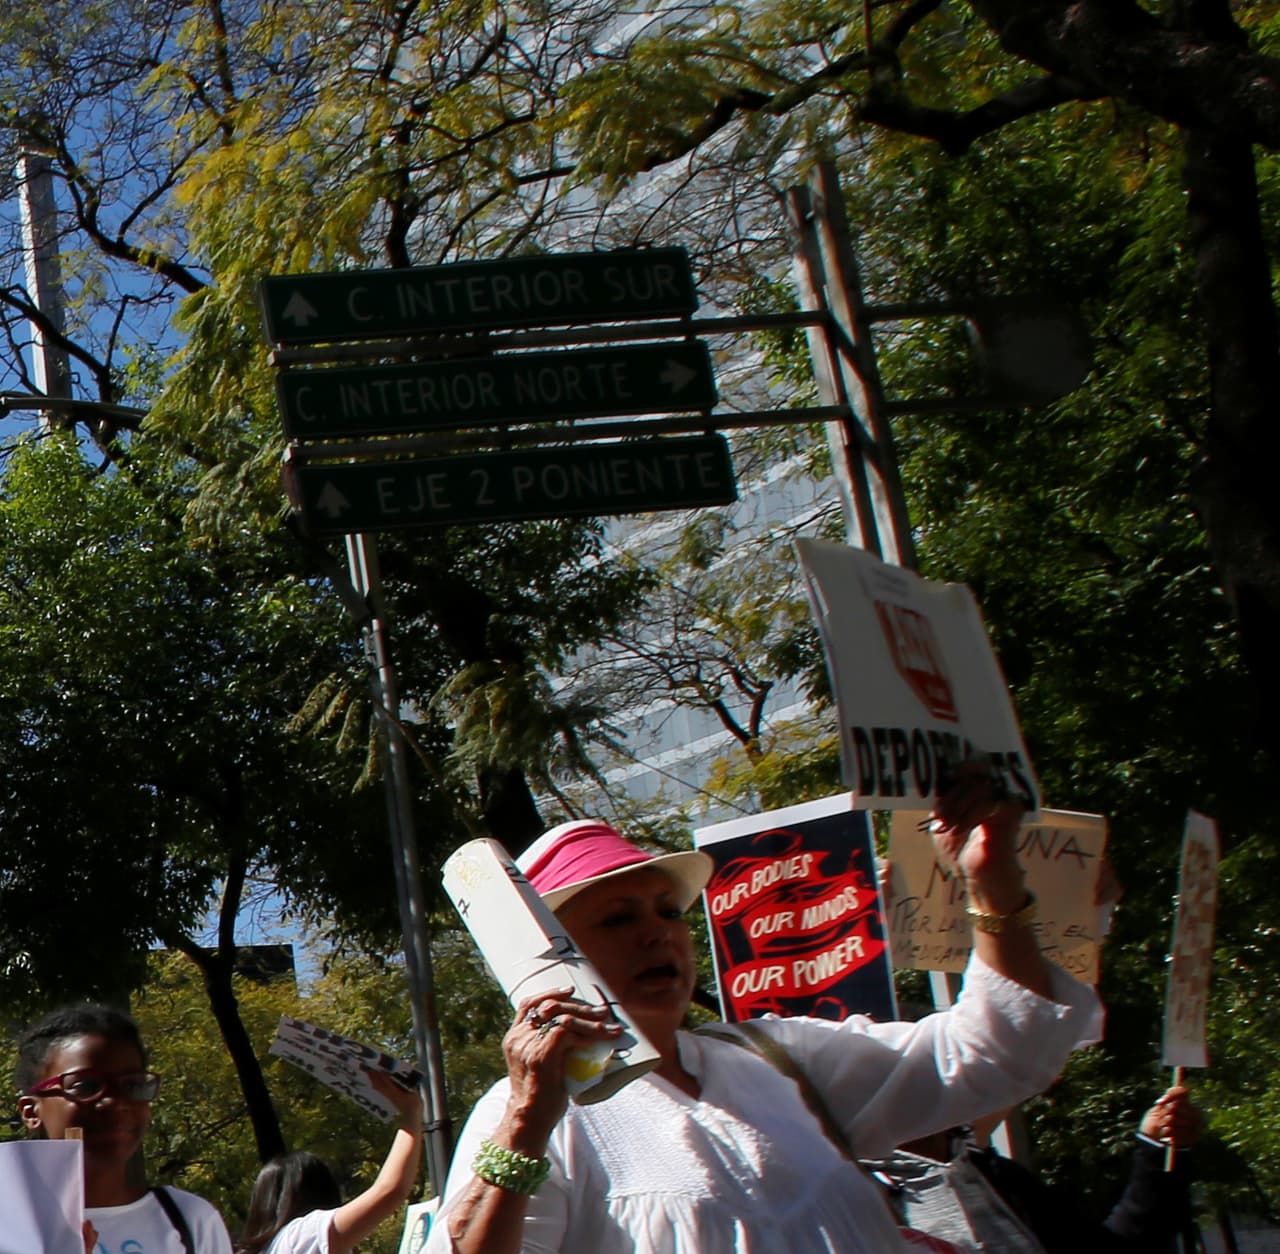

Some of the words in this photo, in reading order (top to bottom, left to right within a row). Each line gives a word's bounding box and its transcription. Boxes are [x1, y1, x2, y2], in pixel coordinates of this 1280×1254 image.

[396, 269, 593, 320] INTERIOR
[603, 263, 681, 303] SUR
[339, 370, 502, 419] INTERIOR
[513, 360, 633, 407] NORTE
[376, 472, 451, 514] EJE
[470, 469, 496, 506] 2
[512, 450, 722, 503] PONIENTE
[711, 882, 750, 916] OUR
[750, 853, 814, 895] BODIES
[749, 911, 795, 939] OUR
[799, 885, 859, 931] MINDS
[731, 965, 786, 998] OUR
[792, 935, 866, 989] POWER
